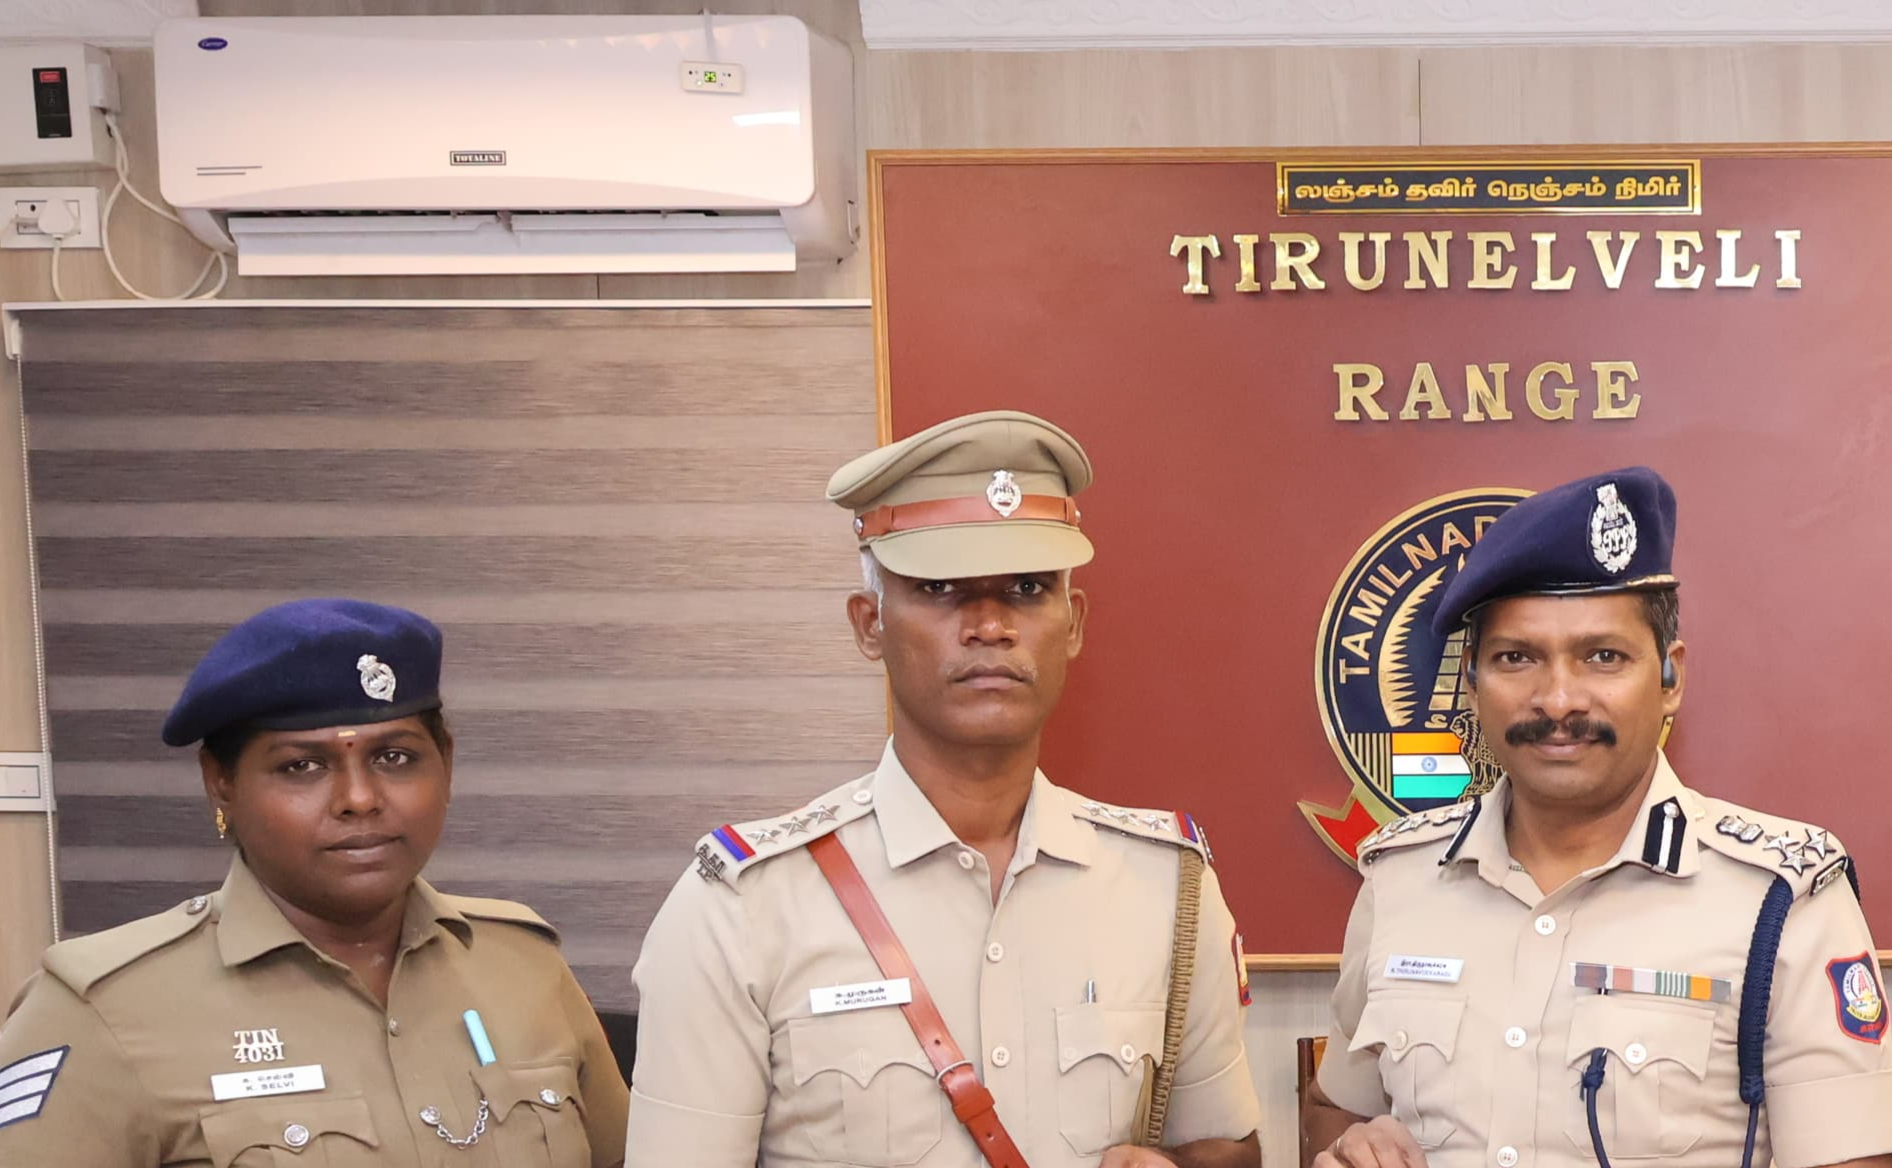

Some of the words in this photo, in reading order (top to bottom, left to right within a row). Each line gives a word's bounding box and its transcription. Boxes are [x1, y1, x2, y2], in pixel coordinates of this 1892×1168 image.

[454, 153, 502, 163] TOTALINE
[1295, 178, 1399, 203] லஞ்சம்
[1405, 177, 1476, 201] தவிர்
[1487, 176, 1606, 202] நெஞ்சம்
[1614, 176, 1682, 201] நிமிர்
[1169, 229, 1802, 294] TIRUNELVELI
[1333, 361, 1642, 422] RANGE
[234, 1028, 281, 1046] TIN
[234, 1042, 285, 1063] 4031
[261, 1080, 295, 1091] SELVI
